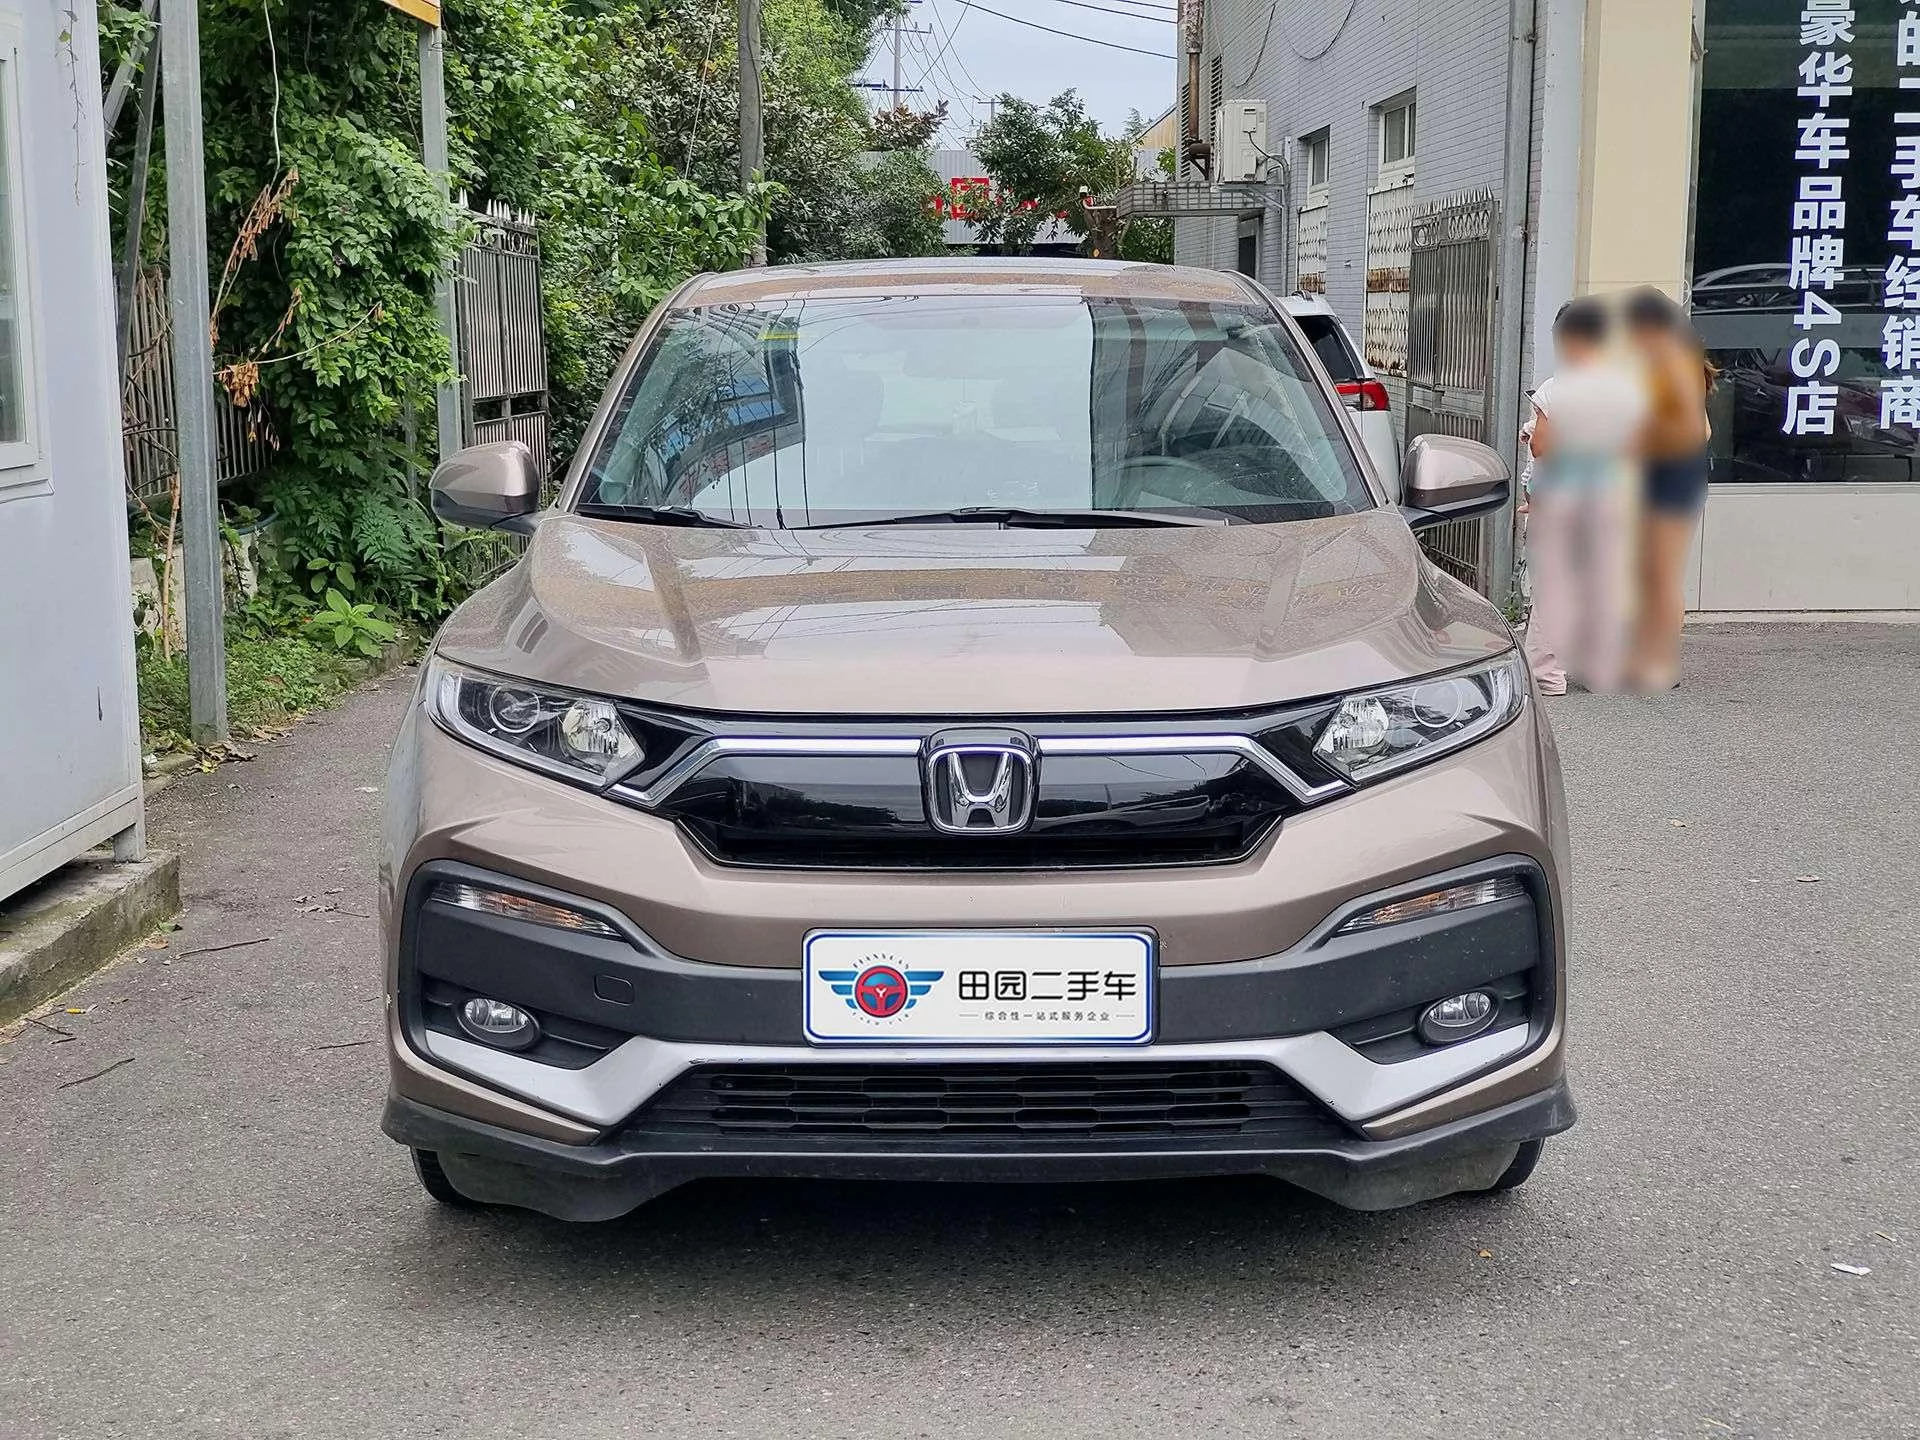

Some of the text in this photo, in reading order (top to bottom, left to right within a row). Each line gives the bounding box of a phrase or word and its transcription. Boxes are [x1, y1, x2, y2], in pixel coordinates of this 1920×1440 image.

[1782, 0, 1856, 436] 豪华车品牌4S店
[958, 970, 1137, 1001] 田园二手车
[985, 1011, 1110, 1022] 综合性一站式服务企业
